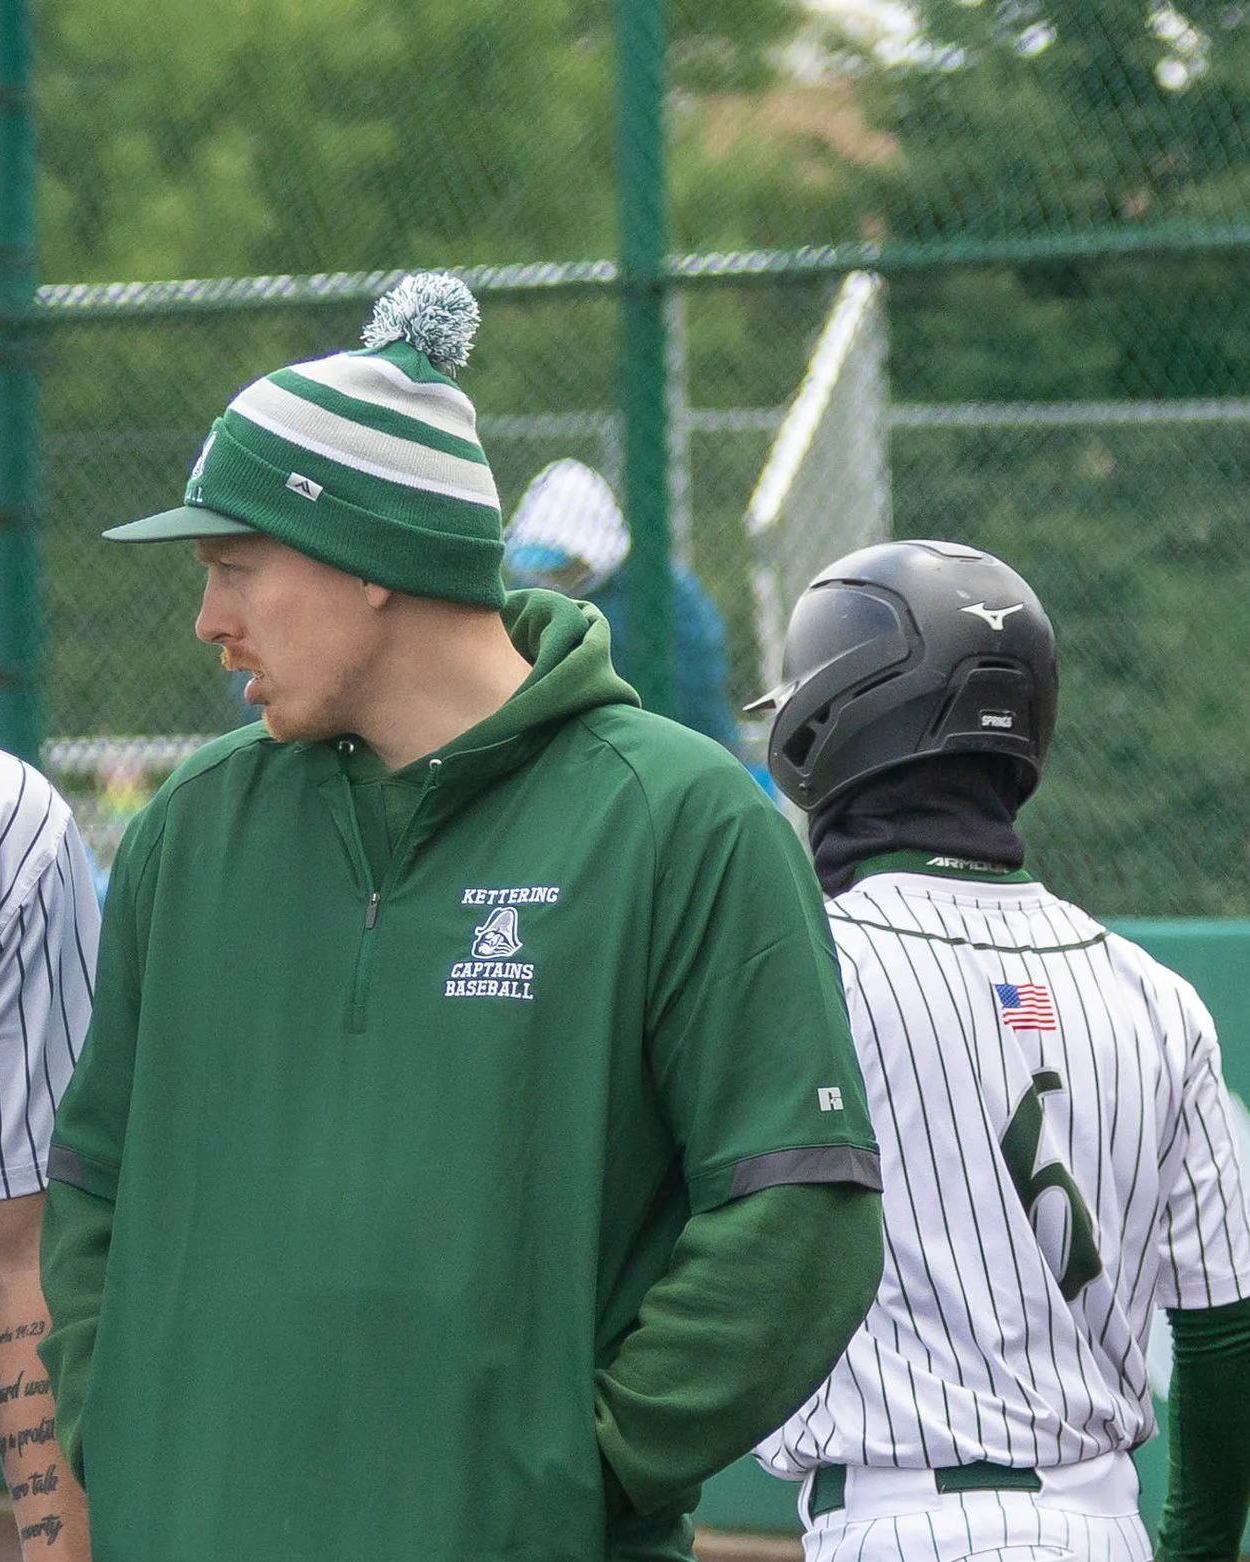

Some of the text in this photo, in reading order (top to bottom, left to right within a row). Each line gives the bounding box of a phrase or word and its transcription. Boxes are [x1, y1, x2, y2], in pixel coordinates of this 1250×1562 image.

[461, 887, 560, 905] KETTERING
[451, 962, 534, 980] CAPTAINS
[444, 980, 534, 1000] BASEBALL
[1000, 1066, 1101, 1304] 6
